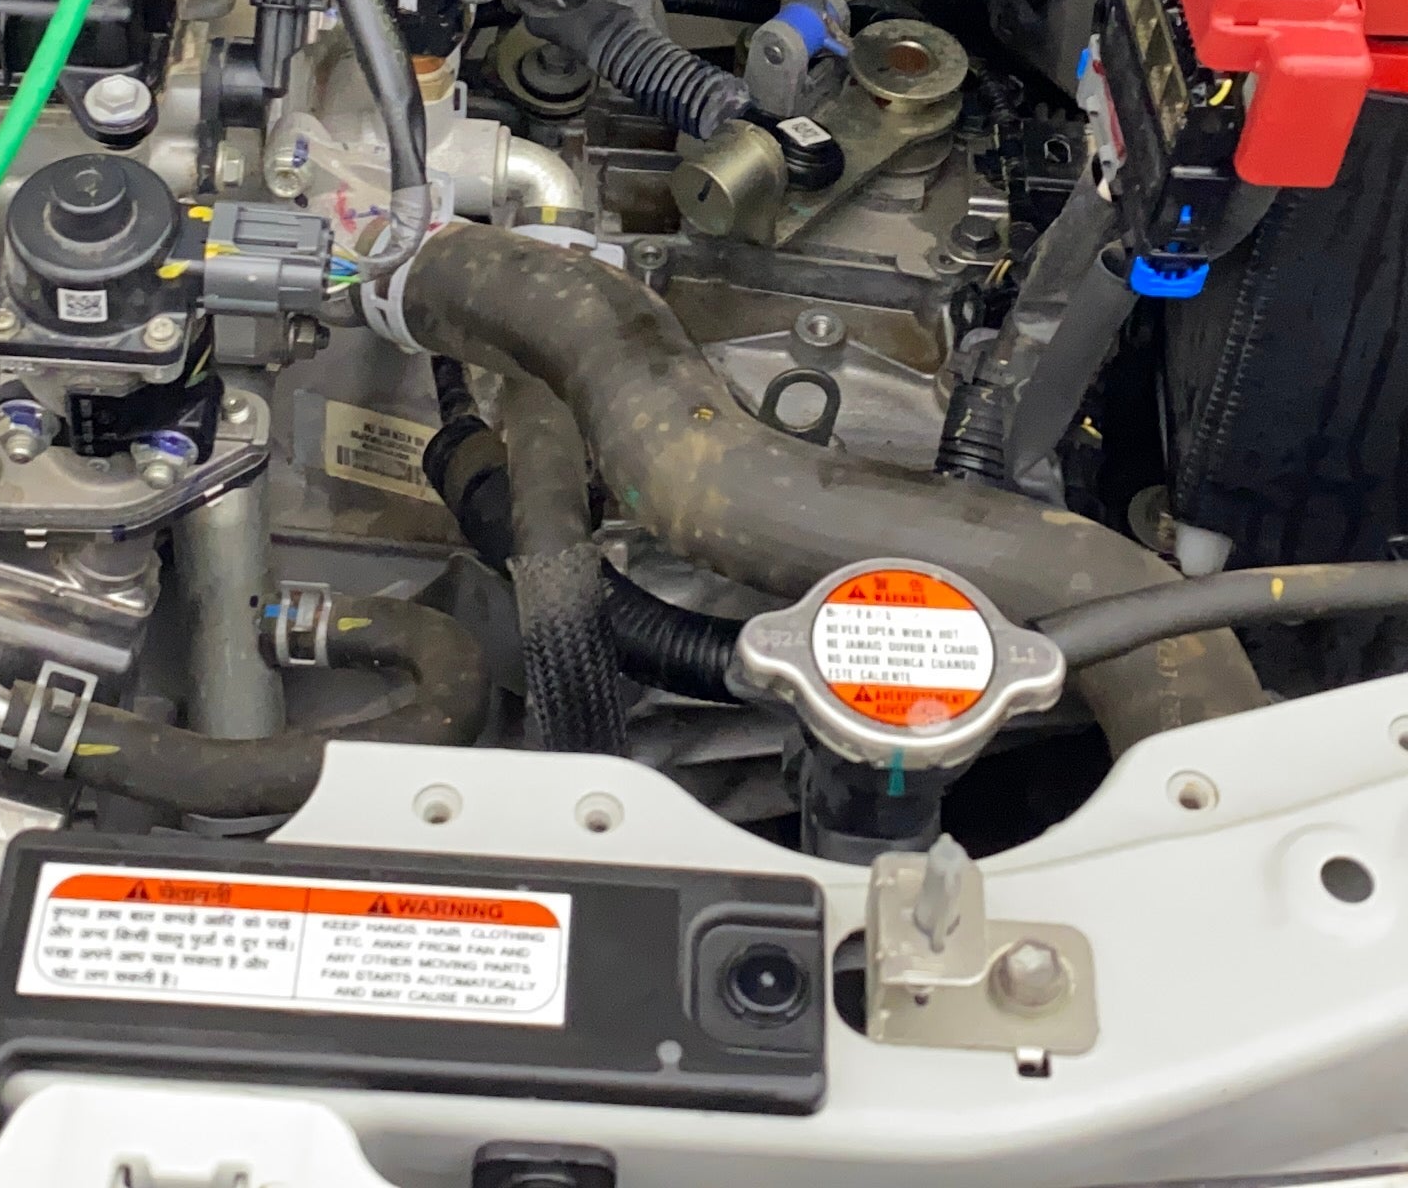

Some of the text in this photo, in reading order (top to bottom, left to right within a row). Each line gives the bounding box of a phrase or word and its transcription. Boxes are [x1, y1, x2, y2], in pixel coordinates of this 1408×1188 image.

[887, 657, 925, 668] NUNCA
[931, 658, 976, 670] CUANDO
[397, 897, 504, 920] WARNING
[322, 920, 360, 931] KEEP
[471, 928, 546, 943] CLOTHING
[372, 939, 412, 950] AWAY
[418, 941, 461, 953] FROM
[467, 944, 496, 955] FAN
[500, 945, 530, 958] AND
[326, 953, 531, 975] ANY OTHER MOVING PARTS
[320, 968, 536, 992] FAN STARTS AUTOMATICALLY
[334, 986, 516, 1007] AND MAY CAUSE INJURY
